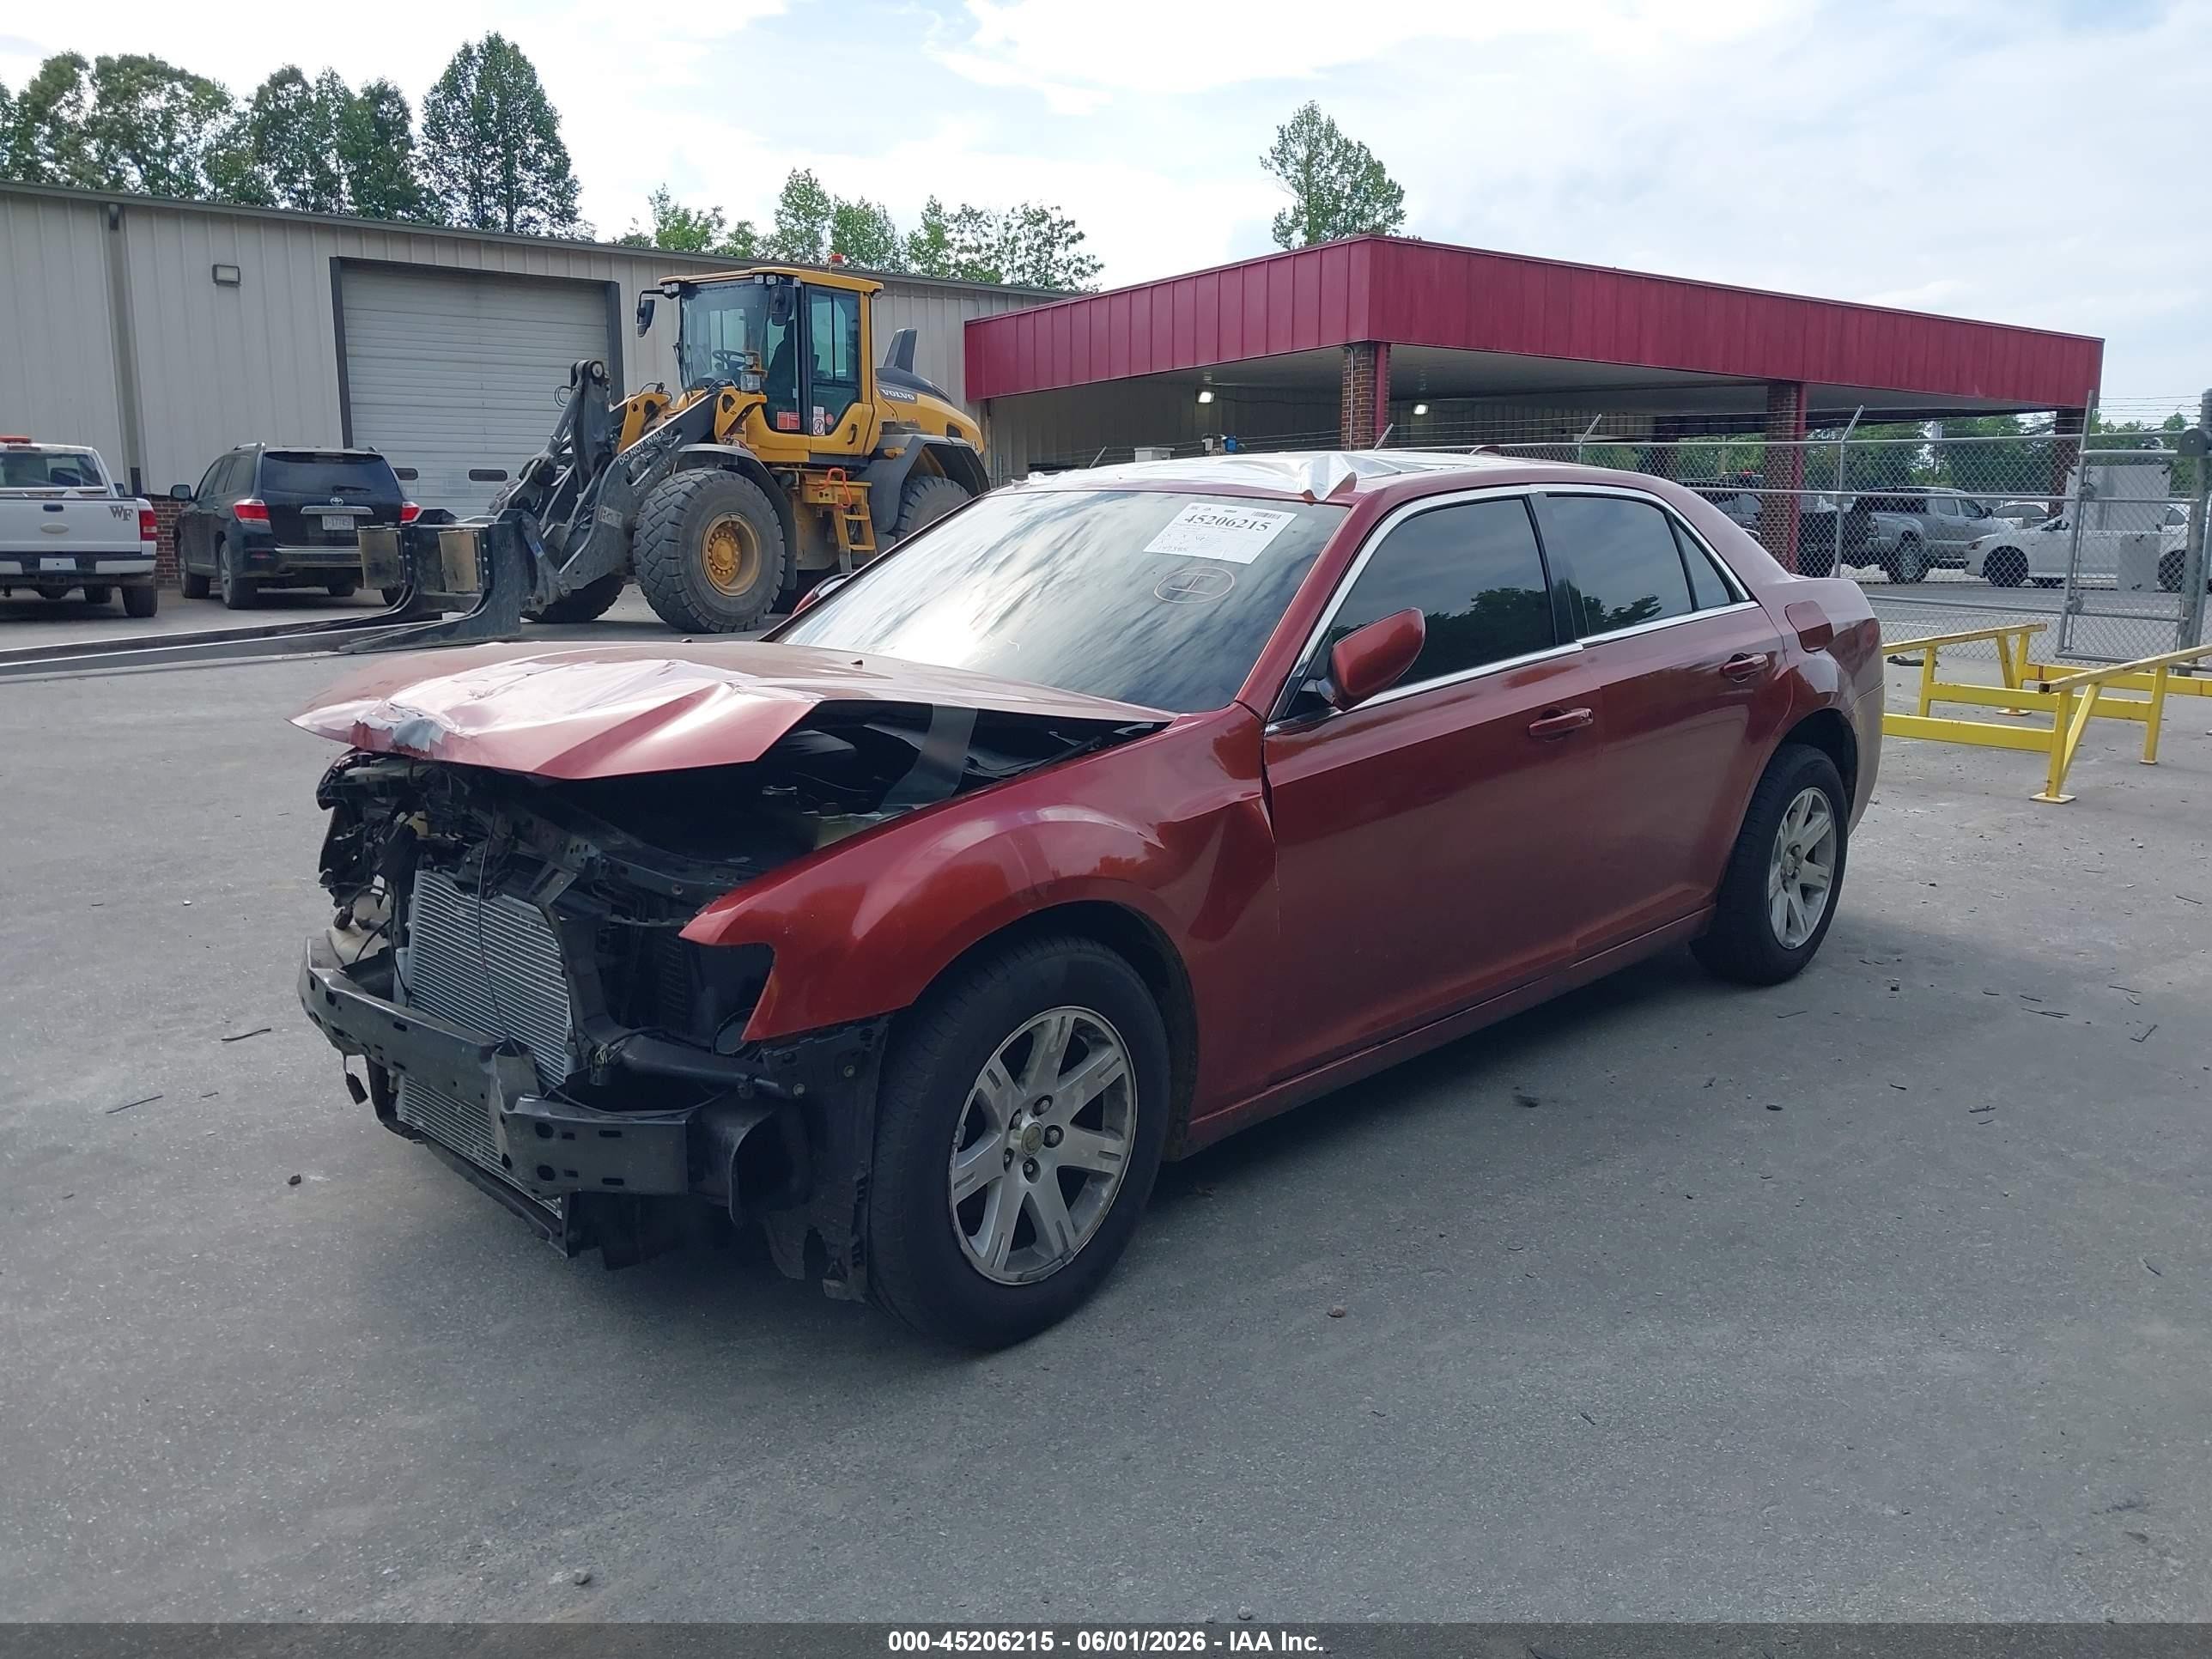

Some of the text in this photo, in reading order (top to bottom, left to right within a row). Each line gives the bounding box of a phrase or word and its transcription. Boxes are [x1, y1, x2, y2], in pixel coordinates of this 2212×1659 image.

[882, 388, 915, 401] VOLVO
[618, 429, 666, 465] DO NOT WALK
[1184, 514, 1272, 532] 45206215
